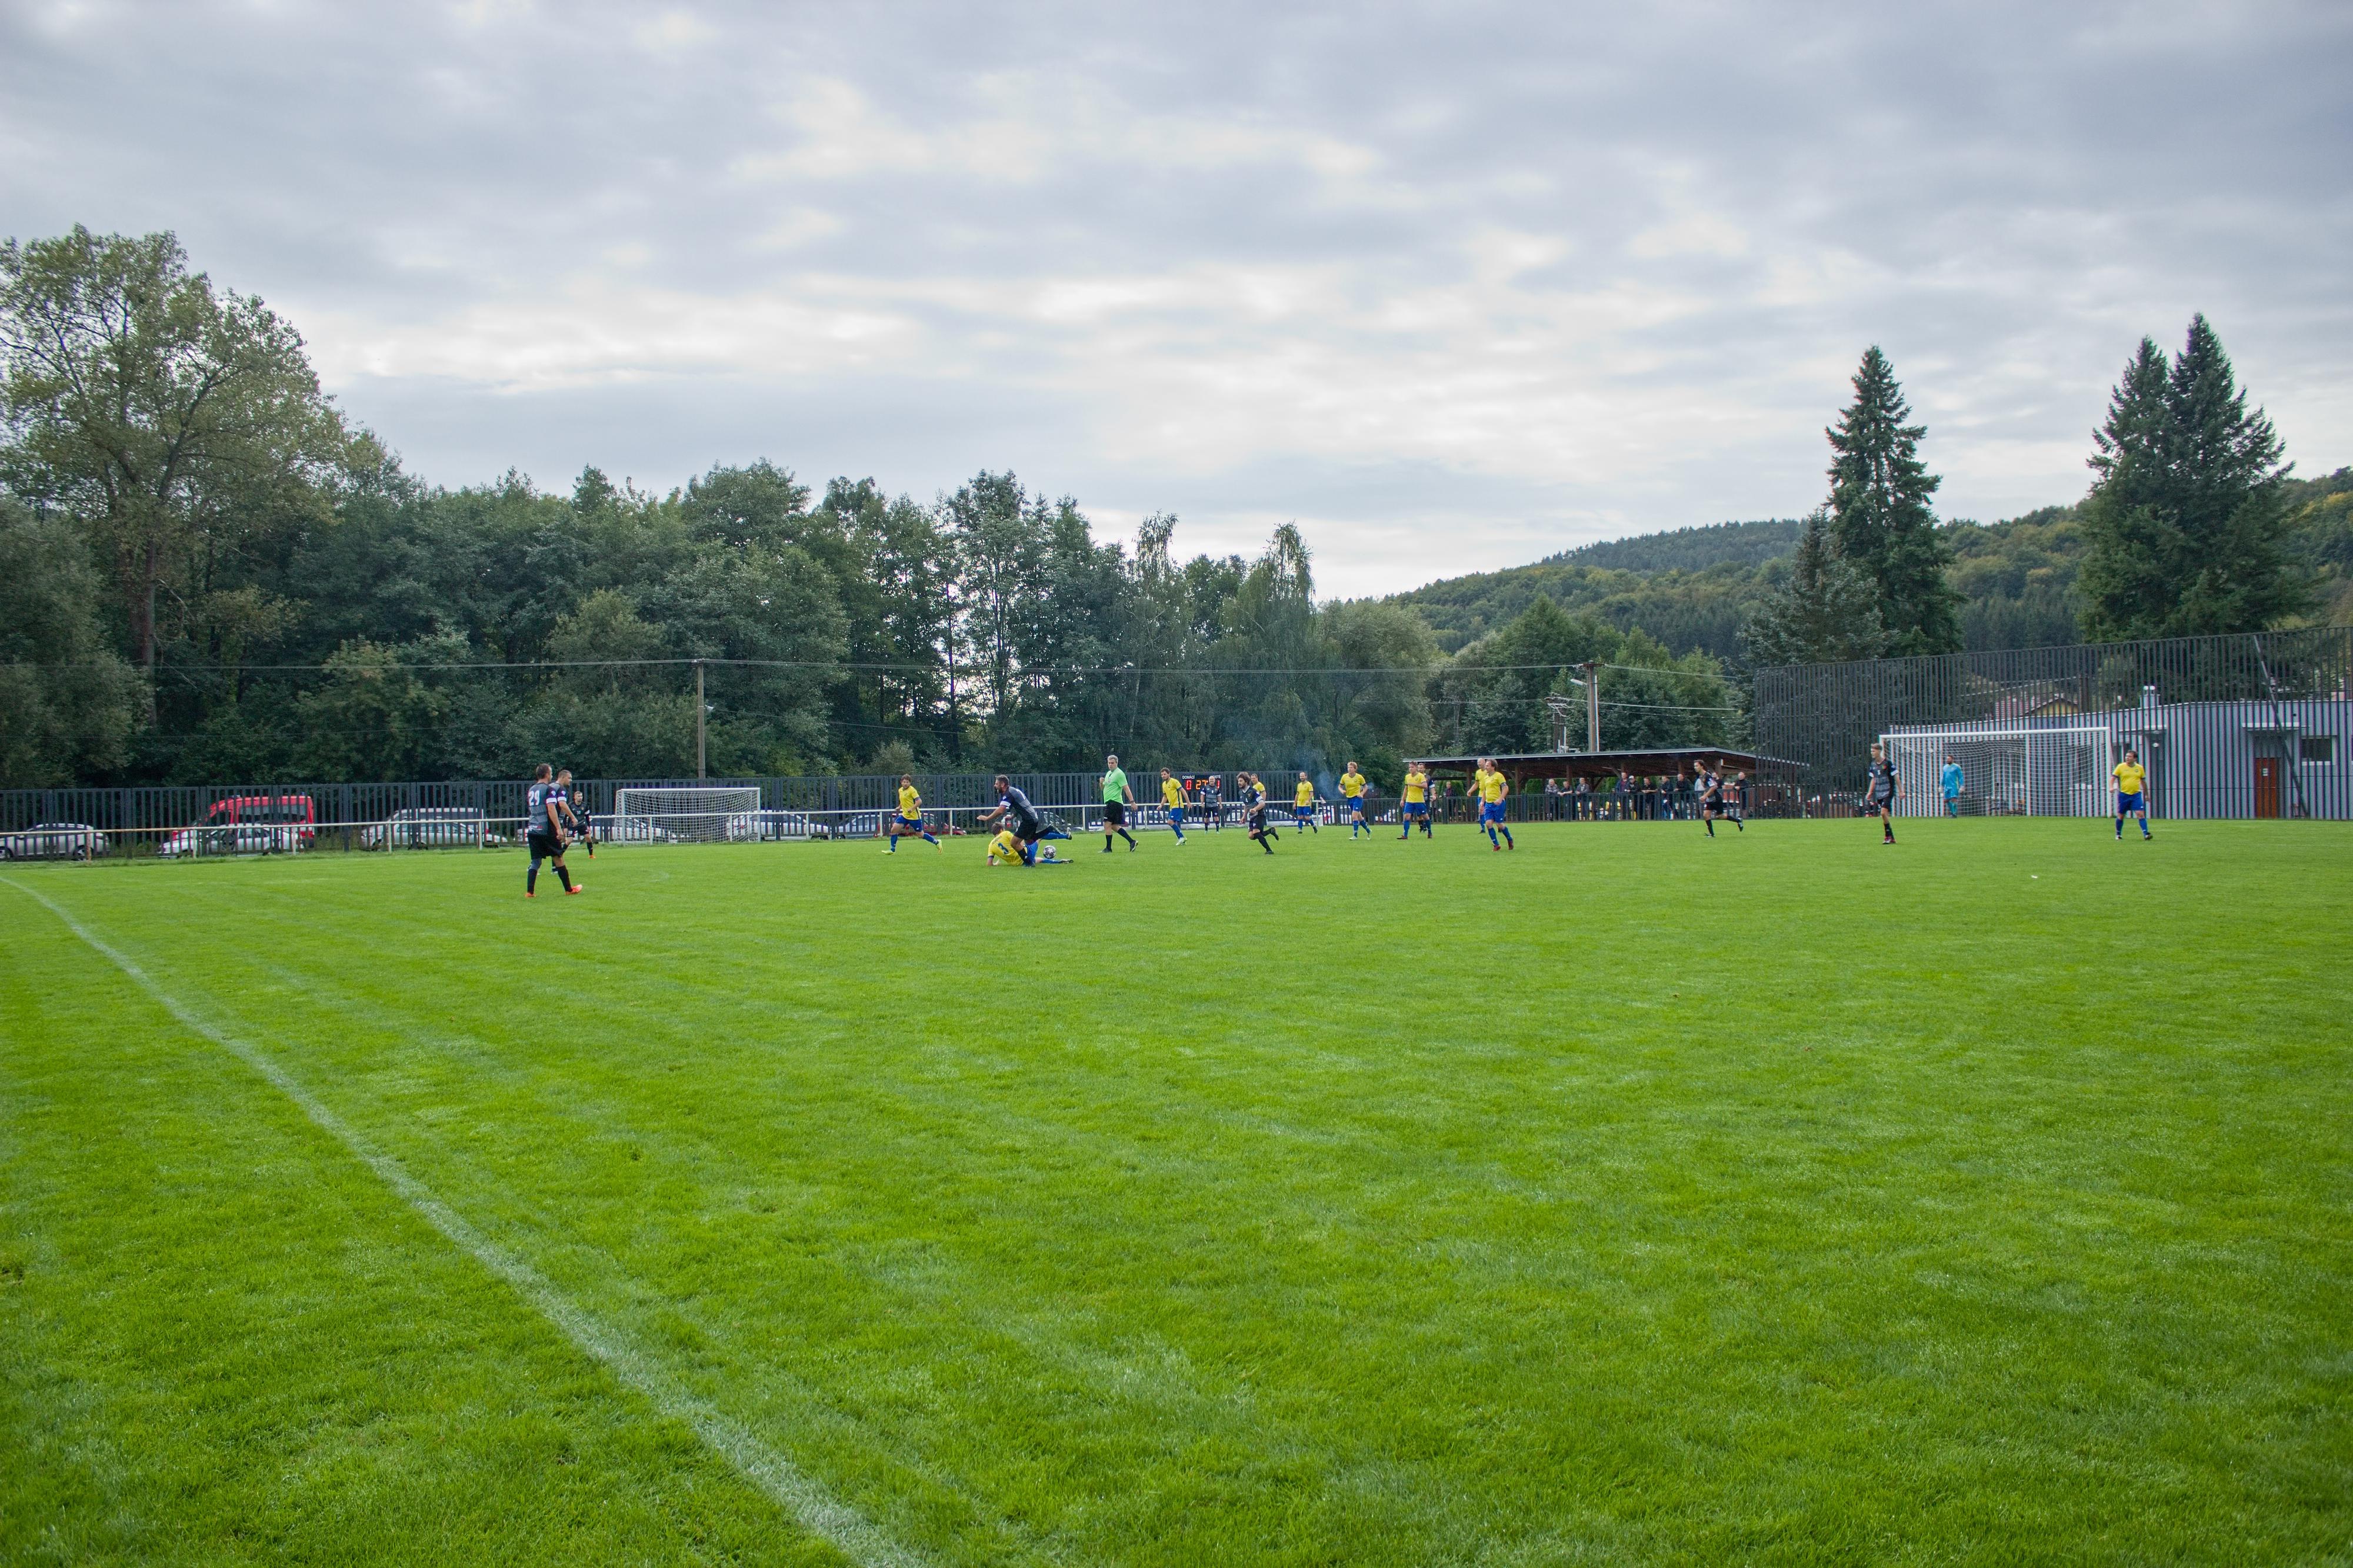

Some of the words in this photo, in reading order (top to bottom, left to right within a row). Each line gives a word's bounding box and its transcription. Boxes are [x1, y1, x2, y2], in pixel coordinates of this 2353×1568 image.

[1186, 780, 1192, 790] 0
[528, 790, 540, 806] 29
[998, 843, 1009, 854] 3
